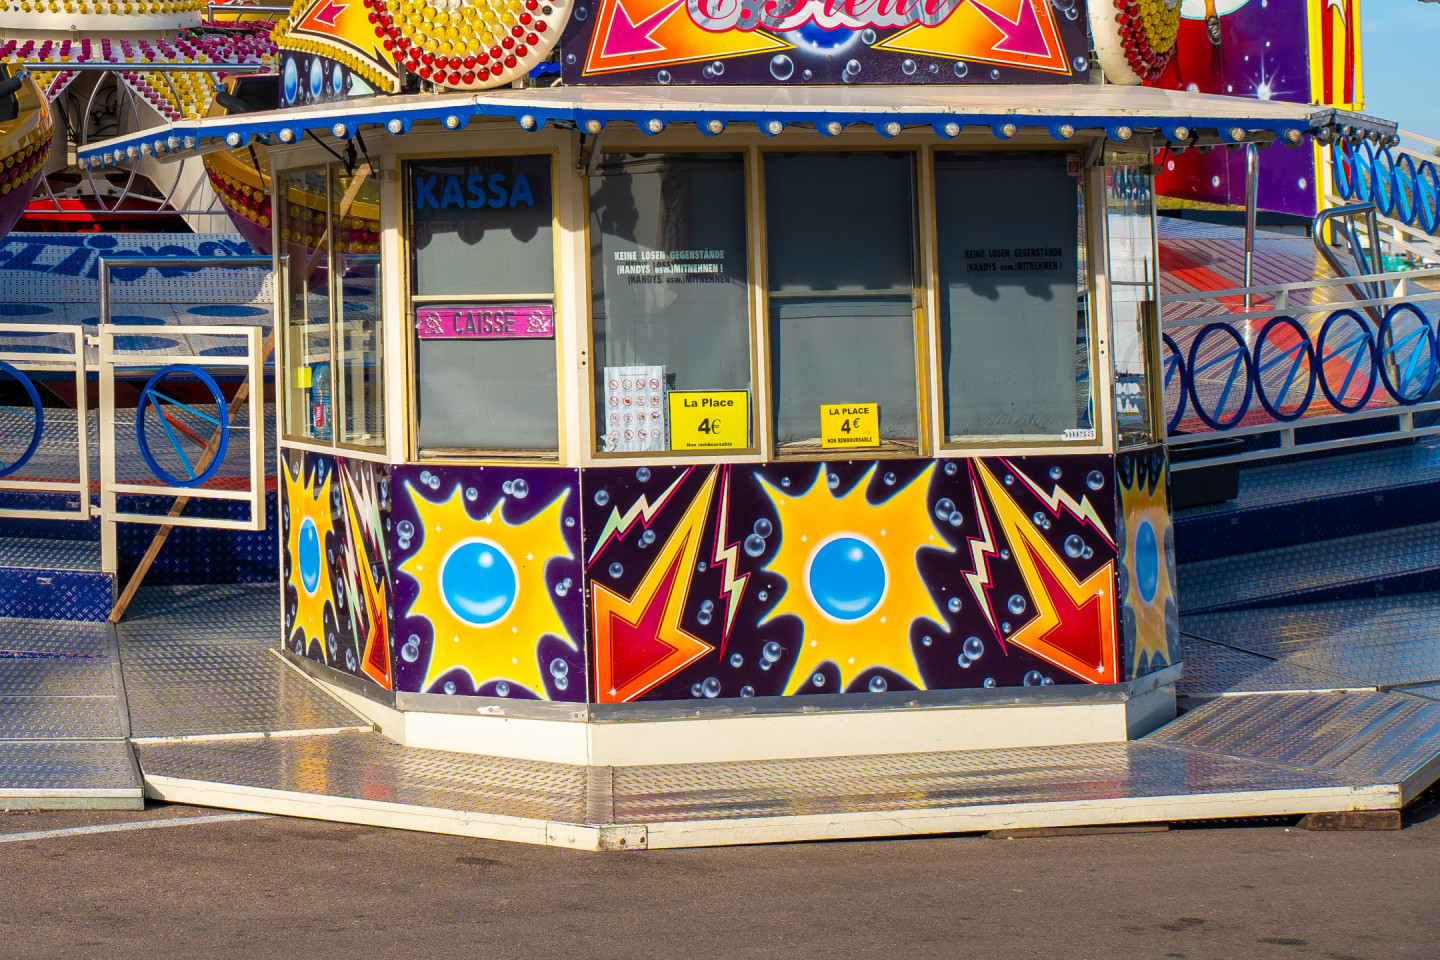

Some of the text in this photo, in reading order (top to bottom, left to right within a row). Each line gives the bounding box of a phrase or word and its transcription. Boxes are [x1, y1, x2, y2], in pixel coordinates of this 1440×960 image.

[1111, 165, 1148, 201] KASSA
[416, 172, 535, 210] KASSA
[614, 251, 637, 260] KEINE
[641, 250, 665, 260] LOSEN
[964, 249, 985, 258] KEINE
[989, 248, 1010, 258] LOSEN
[616, 265, 650, 276] (HANDYS
[453, 311, 517, 335] CAISSE
[684, 398, 734, 408] La Place
[842, 407, 870, 416] PLACE
[697, 417, 722, 435] 4€
[838, 436, 873, 444] REMBOURSABLE
